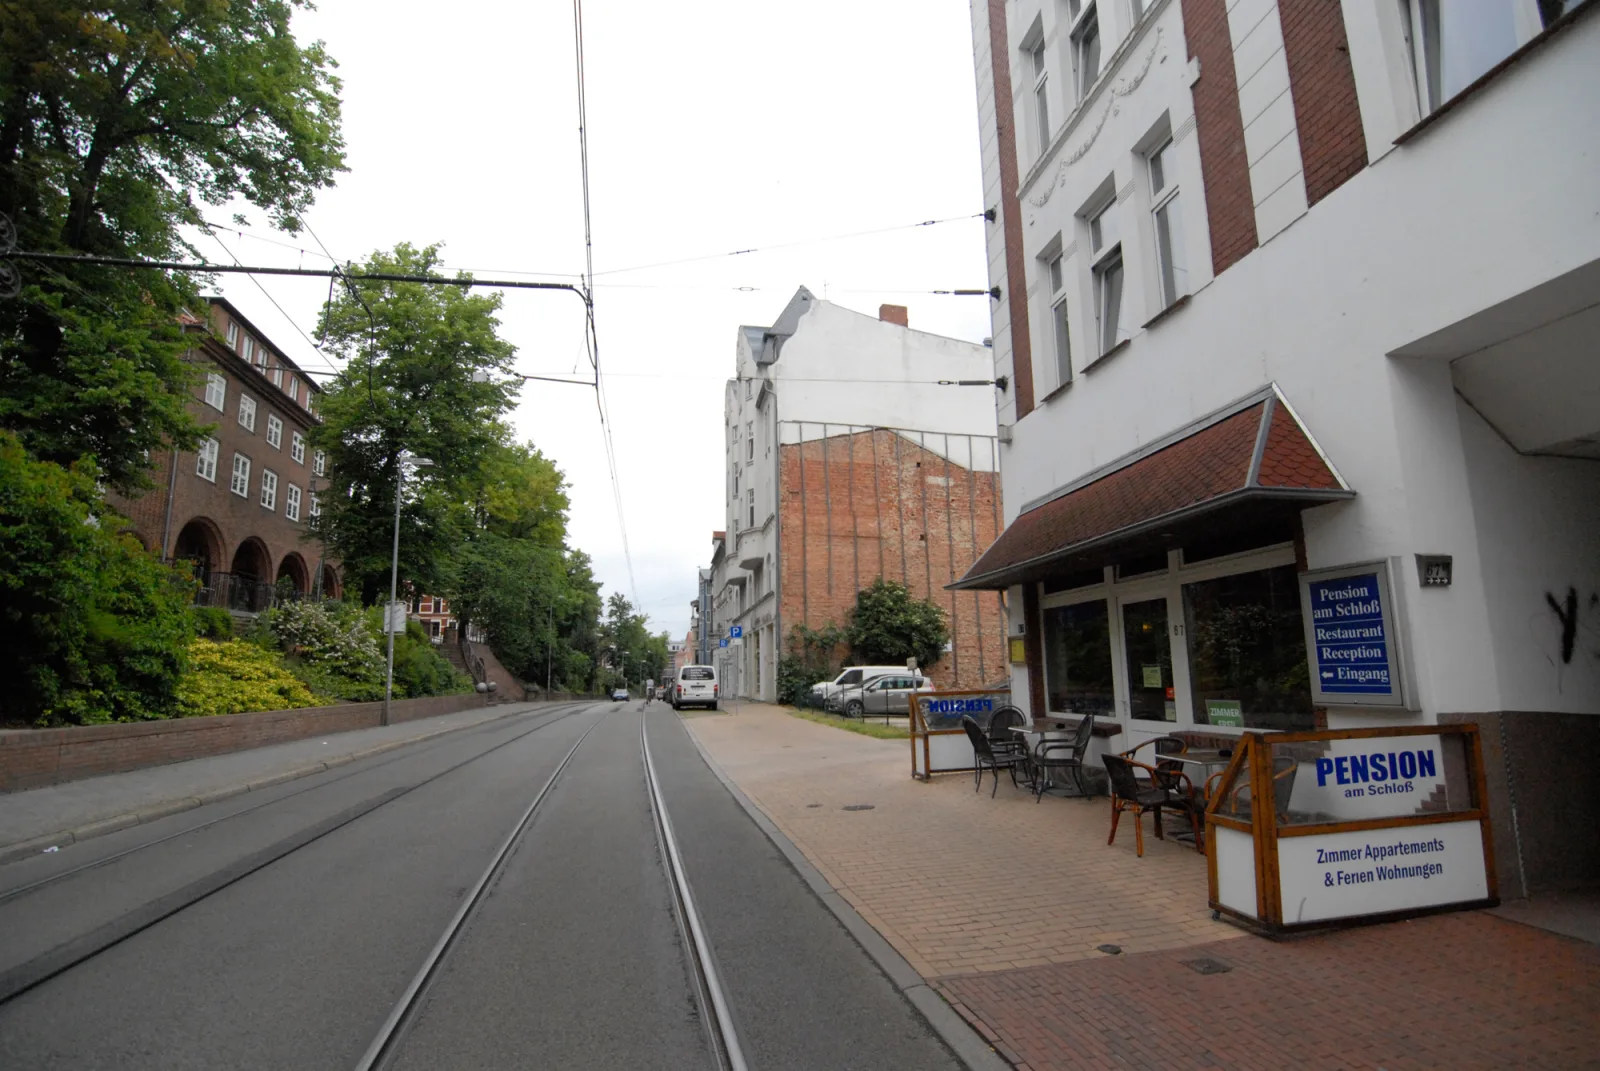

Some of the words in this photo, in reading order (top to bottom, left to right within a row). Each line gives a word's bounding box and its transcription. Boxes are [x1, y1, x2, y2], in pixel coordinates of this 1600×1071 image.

[1319, 585, 1369, 602] Pension
[1313, 608, 1333, 619] am
[1335, 600, 1380, 617] Schloß
[1316, 625, 1383, 641] Restaurant
[1322, 645, 1382, 662] Reception
[1337, 667, 1389, 682] Eingang
[1209, 707, 1241, 717] ZIMMER
[1315, 749, 1437, 787] PENSION
[1344, 787, 1365, 798] am
[1367, 781, 1415, 797] Schloß
[1316, 847, 1362, 864] Zimmer
[1364, 837, 1445, 863] Appartements
[1323, 872, 1334, 887] &
[1336, 869, 1374, 887] Ferien
[1375, 862, 1443, 883] Wohnungen
